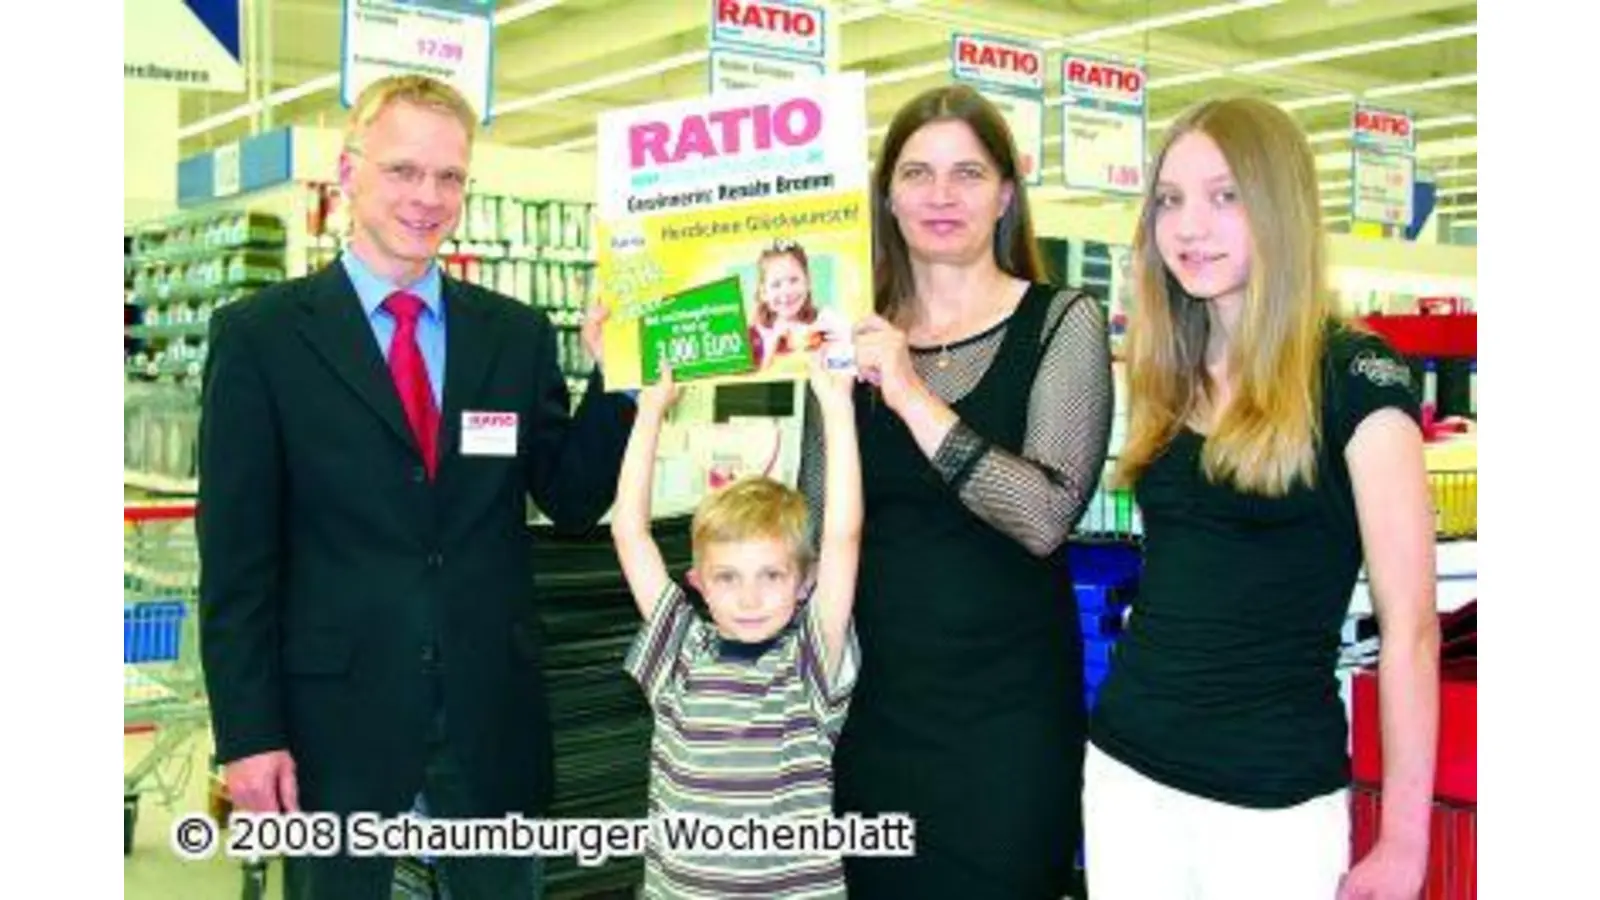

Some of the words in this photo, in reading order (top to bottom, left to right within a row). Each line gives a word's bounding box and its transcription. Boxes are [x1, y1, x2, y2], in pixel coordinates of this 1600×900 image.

[716, 0, 815, 36] RATIO
[958, 40, 1039, 75] RATIO
[1067, 60, 1141, 92] RATIO
[628, 97, 823, 170] RATIO
[1355, 111, 1410, 136] RATIO
[702, 331, 742, 359] Euro
